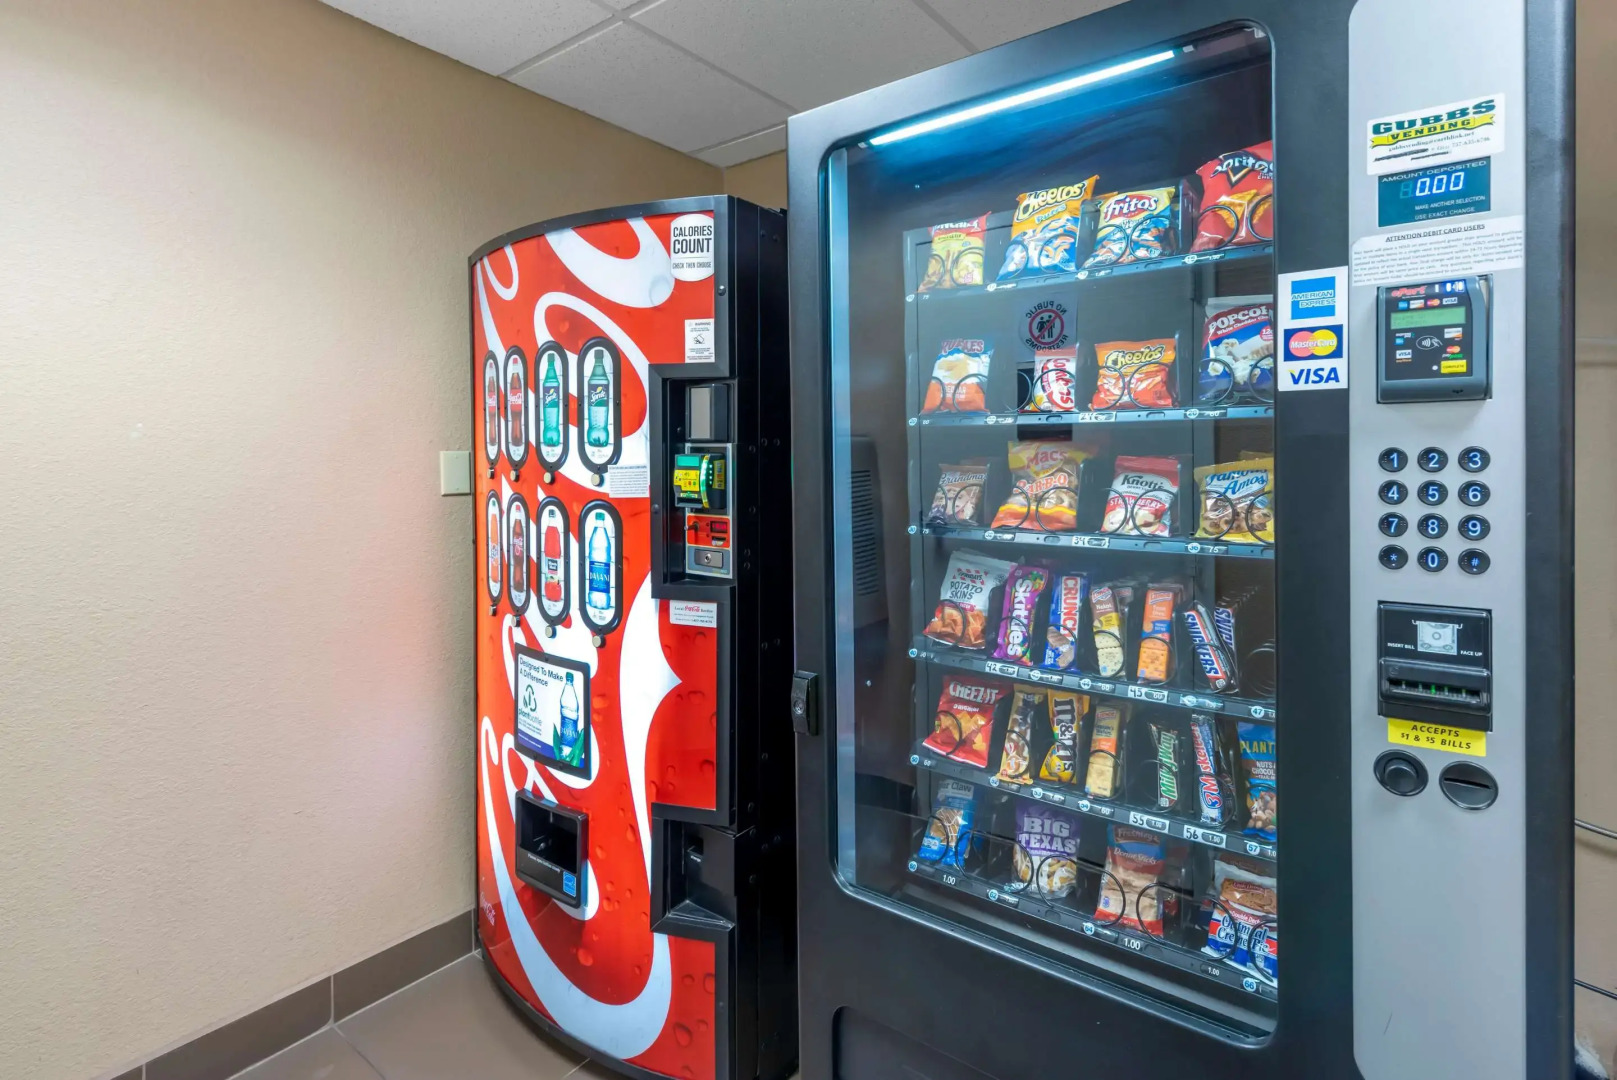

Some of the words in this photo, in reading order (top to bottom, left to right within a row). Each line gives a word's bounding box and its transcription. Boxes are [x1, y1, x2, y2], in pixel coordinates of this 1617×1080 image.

[1372, 99, 1496, 135] GUBBS
[1390, 119, 1471, 140] VENDING
[1382, 171, 1424, 182] AMOUNT
[1426, 160, 1487, 175] DEPOSITED
[1017, 182, 1085, 221] Cheetos
[1104, 194, 1158, 222] Fritos
[1430, 199, 1455, 209] ANOTHER
[1456, 195, 1486, 206] SELECTION
[1428, 210, 1447, 218] EXACT
[1449, 206, 1475, 216] CHANGE
[673, 225, 713, 238] CALORIES
[1385, 232, 1422, 243] ATTENTION
[1423, 229, 1442, 238] DEBIT
[1444, 226, 1462, 235] CARD
[1463, 223, 1486, 232] USERS
[673, 238, 712, 254] COUNT
[672, 262, 685, 270] CHECK
[685, 261, 696, 269] THEN
[696, 260, 712, 269] CHOOSE
[1291, 290, 1333, 300] AMERICAN
[1300, 299, 1336, 308] EXPRESS
[1290, 338, 1337, 349] MasterCard
[1106, 345, 1164, 371] Cheetos
[1288, 367, 1340, 385] VISA
[1390, 453, 1398, 468] 1
[1428, 453, 1439, 467] 2
[1468, 452, 1482, 468] 3
[1218, 475, 1266, 497] Amos
[1388, 485, 1399, 500] 4
[1427, 486, 1439, 501] 5
[1468, 486, 1481, 502] 6
[1388, 518, 1399, 533] 7
[1428, 519, 1438, 535] 8
[1468, 520, 1481, 536] 9
[1428, 552, 1438, 567] 0
[949, 590, 975, 600] SKINS
[950, 581, 983, 594] POTATO
[1061, 577, 1079, 641] CRUNCH
[1007, 578, 1033, 656] Skittles
[1387, 642, 1404, 650] INSERT
[519, 657, 540, 673] Designed
[540, 667, 548, 676] To
[547, 669, 564, 682] Make
[986, 662, 998, 671] 42
[523, 669, 549, 687] Difference
[949, 682, 999, 704] CHEEZ-IT
[1129, 687, 1143, 697] 45
[1411, 724, 1460, 738] ACCEPTS
[1239, 741, 1275, 754] PLANT
[1401, 732, 1409, 741] $1
[1413, 734, 1421, 742] &
[1426, 736, 1436, 745] $5
[1440, 738, 1472, 750] BILLS
[1251, 767, 1275, 776] CHOCOL
[951, 781, 972, 792] Claw
[1023, 816, 1070, 837] BIG
[1132, 815, 1145, 825] 55
[1186, 827, 1199, 839] 56
[1018, 833, 1077, 854] TEXAS
[1248, 843, 1258, 851] 57
[943, 874, 956, 885] 1.00
[1222, 916, 1269, 940] Otmal
[1123, 938, 1141, 950] 1.00
[1251, 938, 1269, 953] Pie
[1208, 966, 1220, 976] 1.00
[1243, 979, 1255, 990] 66
